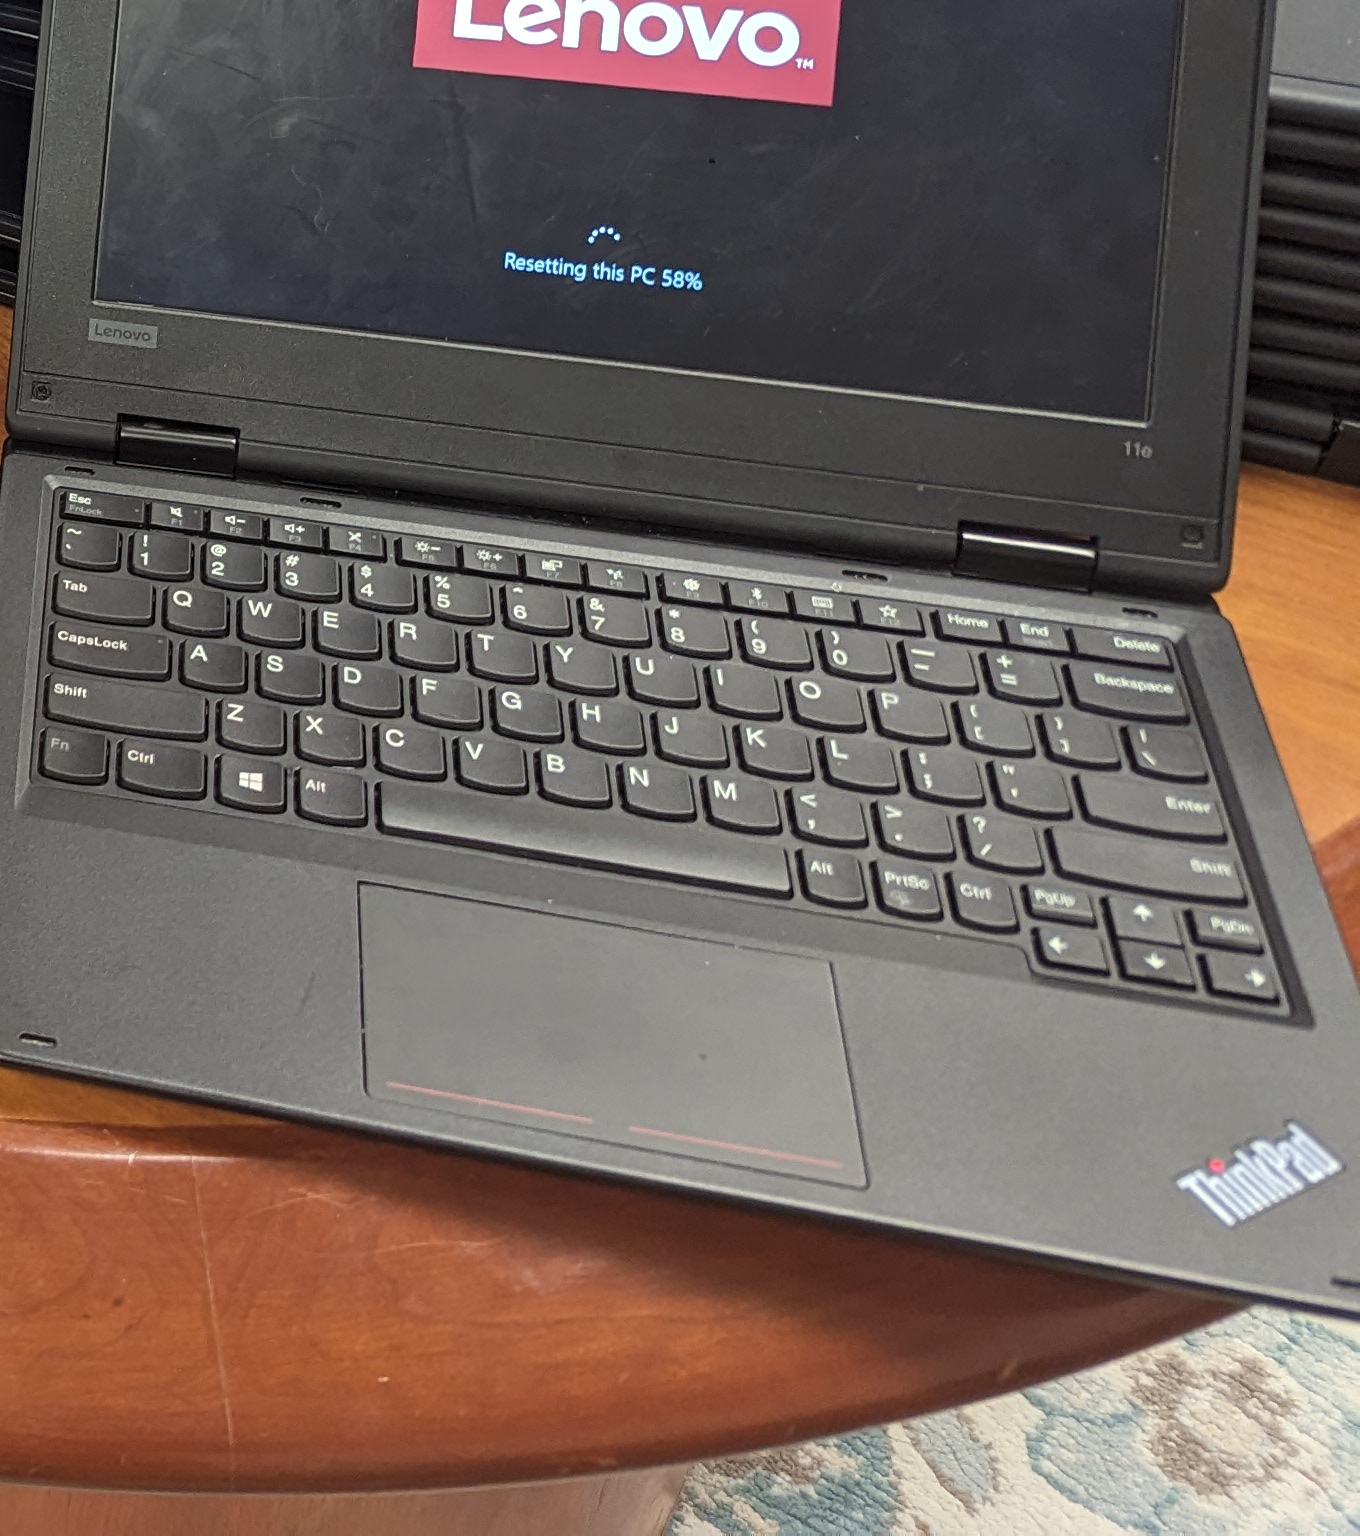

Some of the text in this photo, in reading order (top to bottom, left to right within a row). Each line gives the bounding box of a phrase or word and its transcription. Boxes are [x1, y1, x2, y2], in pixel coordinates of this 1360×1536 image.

[504, 251, 704, 291] Resetting this PC 58%
[95, 322, 151, 342] Lenovo
[1123, 440, 1153, 460] 11e
[68, 492, 92, 505] Esc
[66, 503, 103, 518] FnLock
[62, 579, 88, 593] Tab
[172, 590, 193, 608] Q
[247, 599, 273, 618] W
[323, 610, 340, 629] E
[947, 613, 989, 628] Home
[399, 621, 417, 641] R
[1019, 623, 1050, 638] End
[57, 630, 128, 651] CapsLock
[477, 633, 495, 652] T
[1113, 635, 1161, 653] Delete
[555, 645, 574, 663] Y
[53, 683, 88, 699] Shift
[1093, 672, 1175, 694] Backspace
[50, 737, 70, 751] Fn
[127, 749, 154, 765] Ctrl
[305, 778, 326, 793] Alt
[1165, 795, 1211, 814] Enter
[810, 860, 833, 876] Alt
[1189, 858, 1232, 877] Shift
[884, 871, 930, 890] PrtSc
[959, 882, 992, 901] Ctrl
[1034, 888, 1076, 908] PgUp
[1175, 1122, 1343, 1228] ThinkPad
